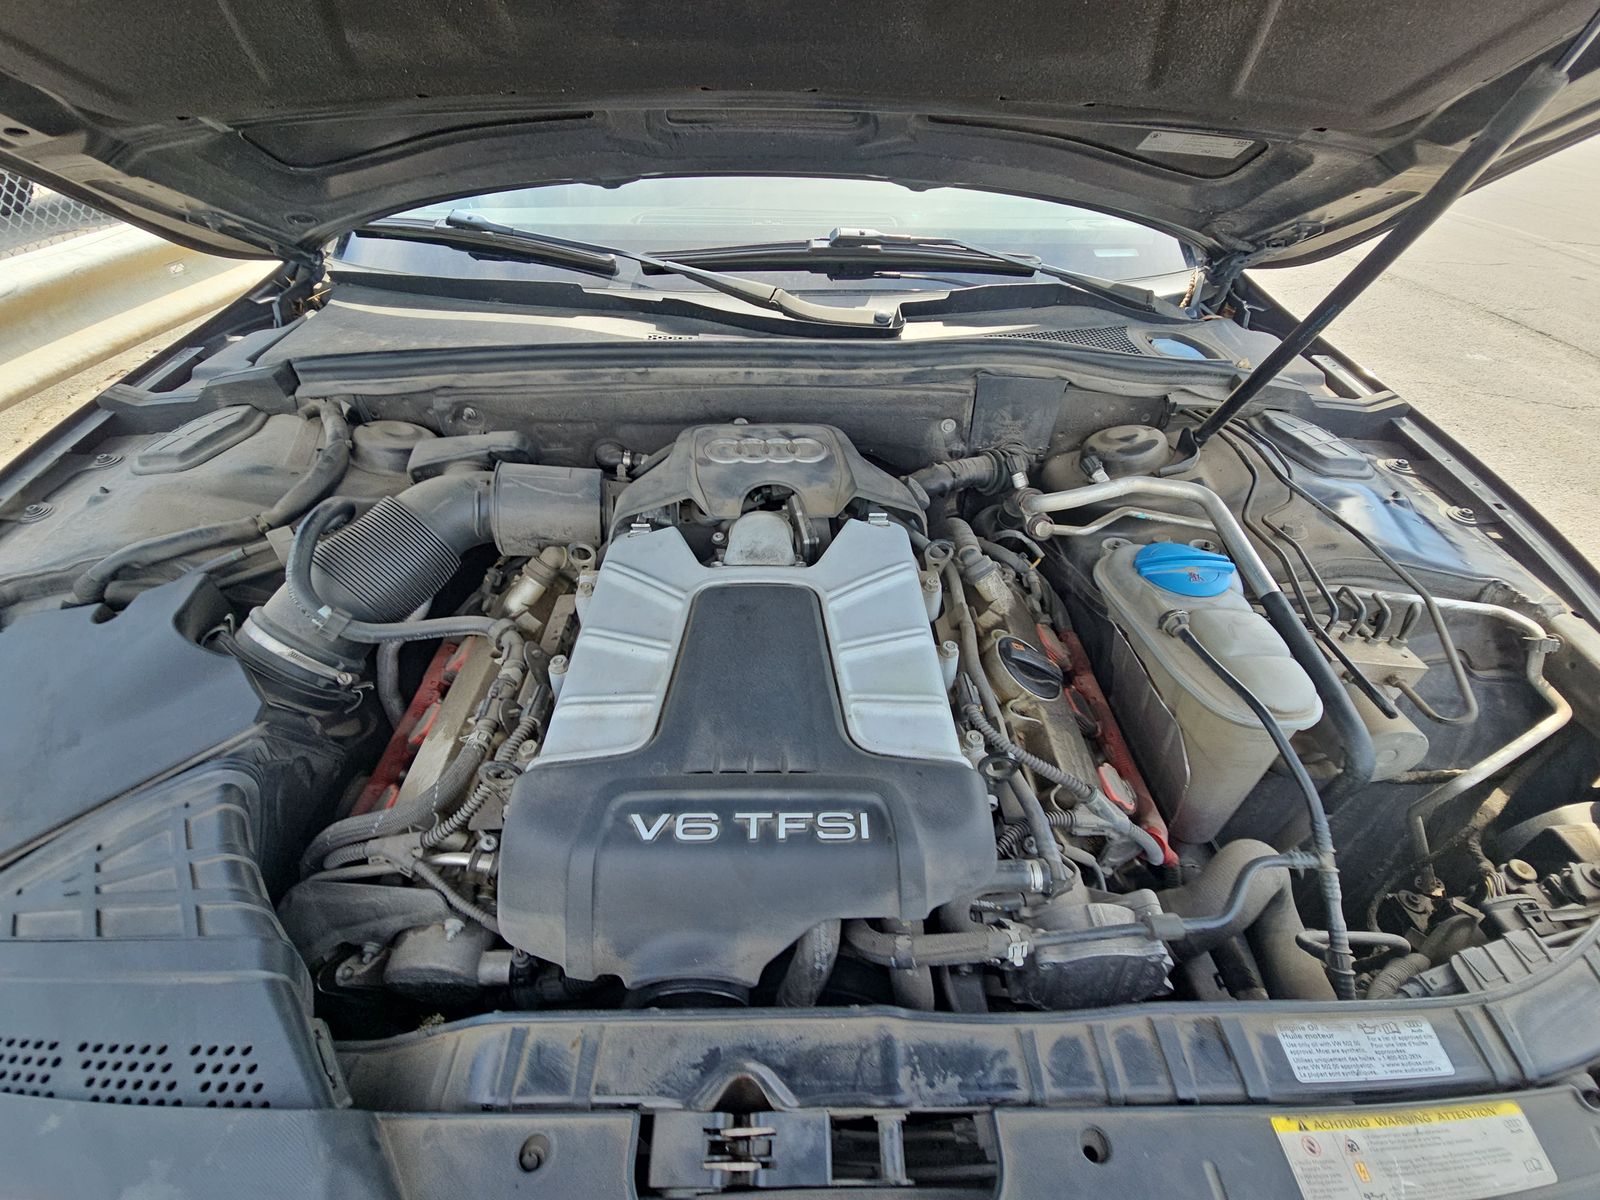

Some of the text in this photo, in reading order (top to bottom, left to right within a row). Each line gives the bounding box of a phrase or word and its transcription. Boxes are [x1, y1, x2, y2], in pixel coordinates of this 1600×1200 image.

[630, 812, 870, 841] V6 TFSI
[1278, 1024, 1319, 1033] Engine Oil
[1281, 1032, 1303, 1040] Huile
[1313, 1106, 1497, 1131] ACHTUNG WARNING ATTENTION
